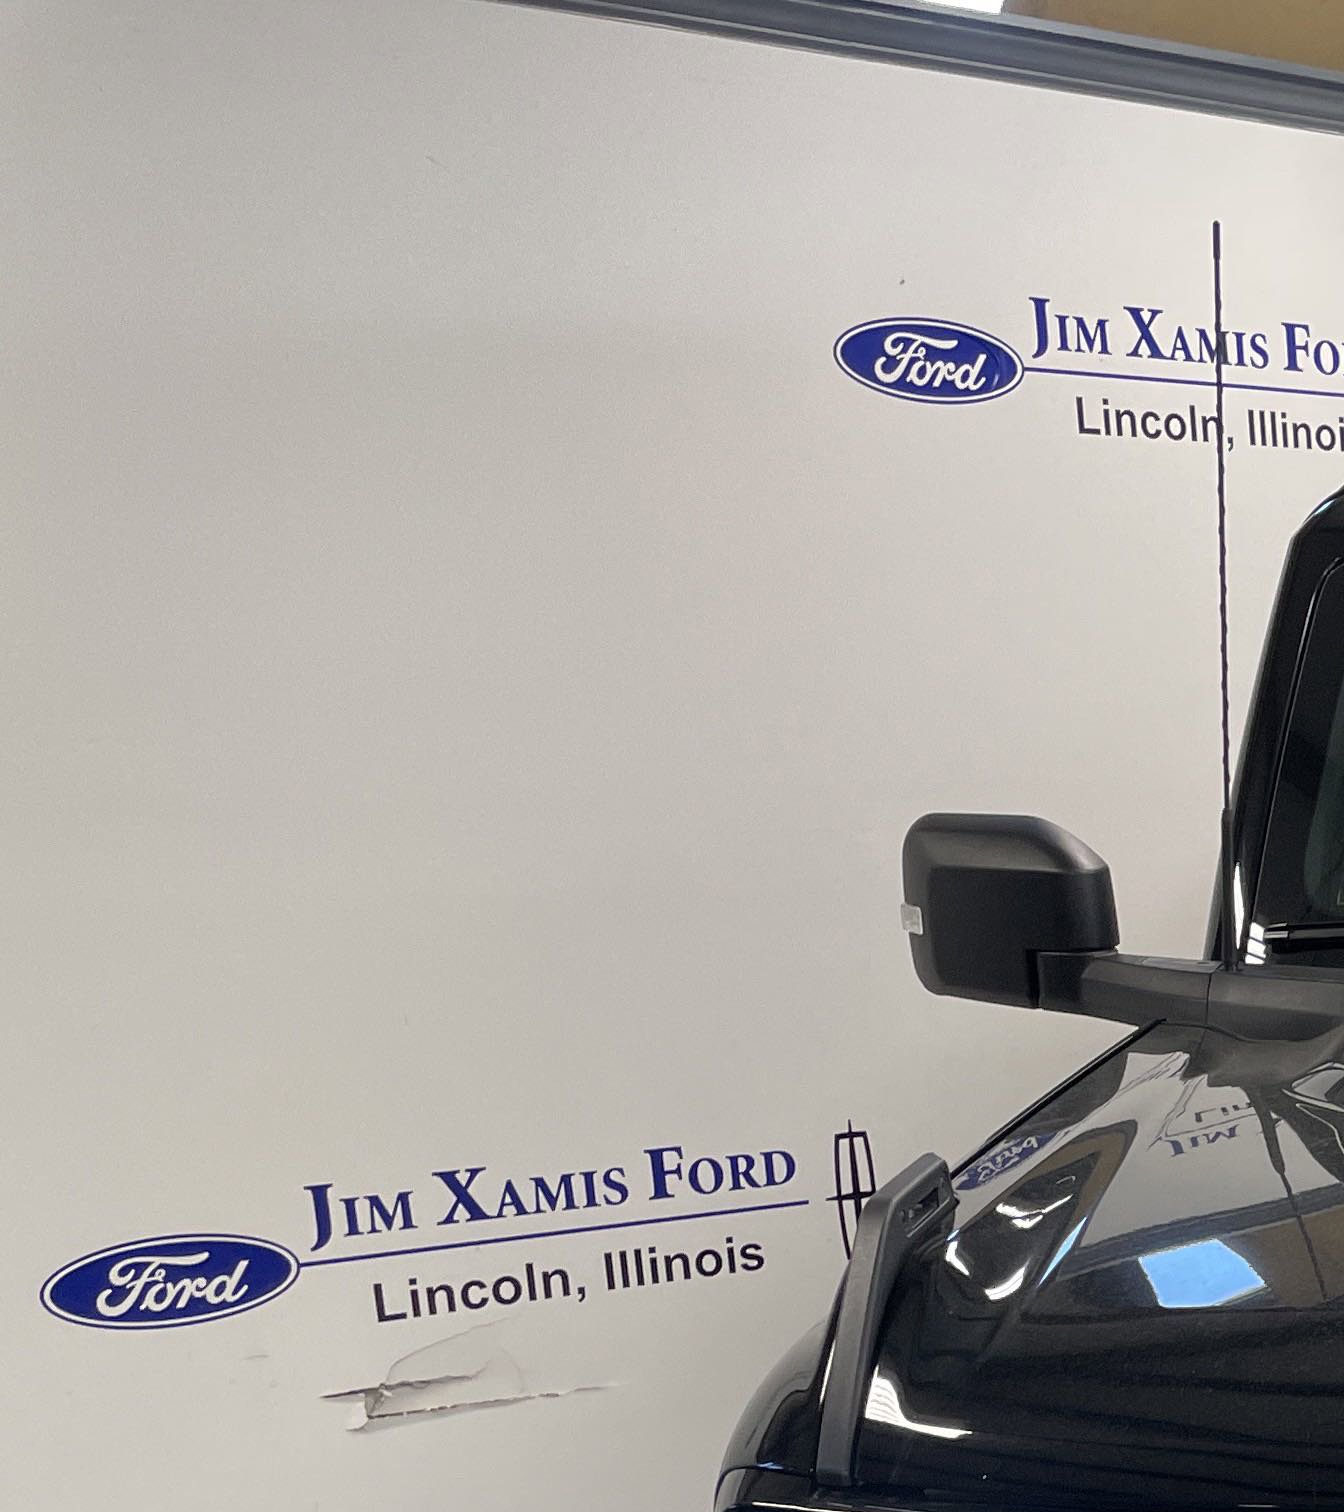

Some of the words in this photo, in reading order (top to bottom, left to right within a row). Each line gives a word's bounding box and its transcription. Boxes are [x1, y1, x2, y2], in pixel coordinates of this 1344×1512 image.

[873, 331, 988, 392] Ford
[1075, 396, 1235, 452] Lincoln,
[95, 1251, 248, 1318] Ford
[372, 1265, 586, 1324] Lincoln,
[604, 1237, 766, 1292] Illinois
